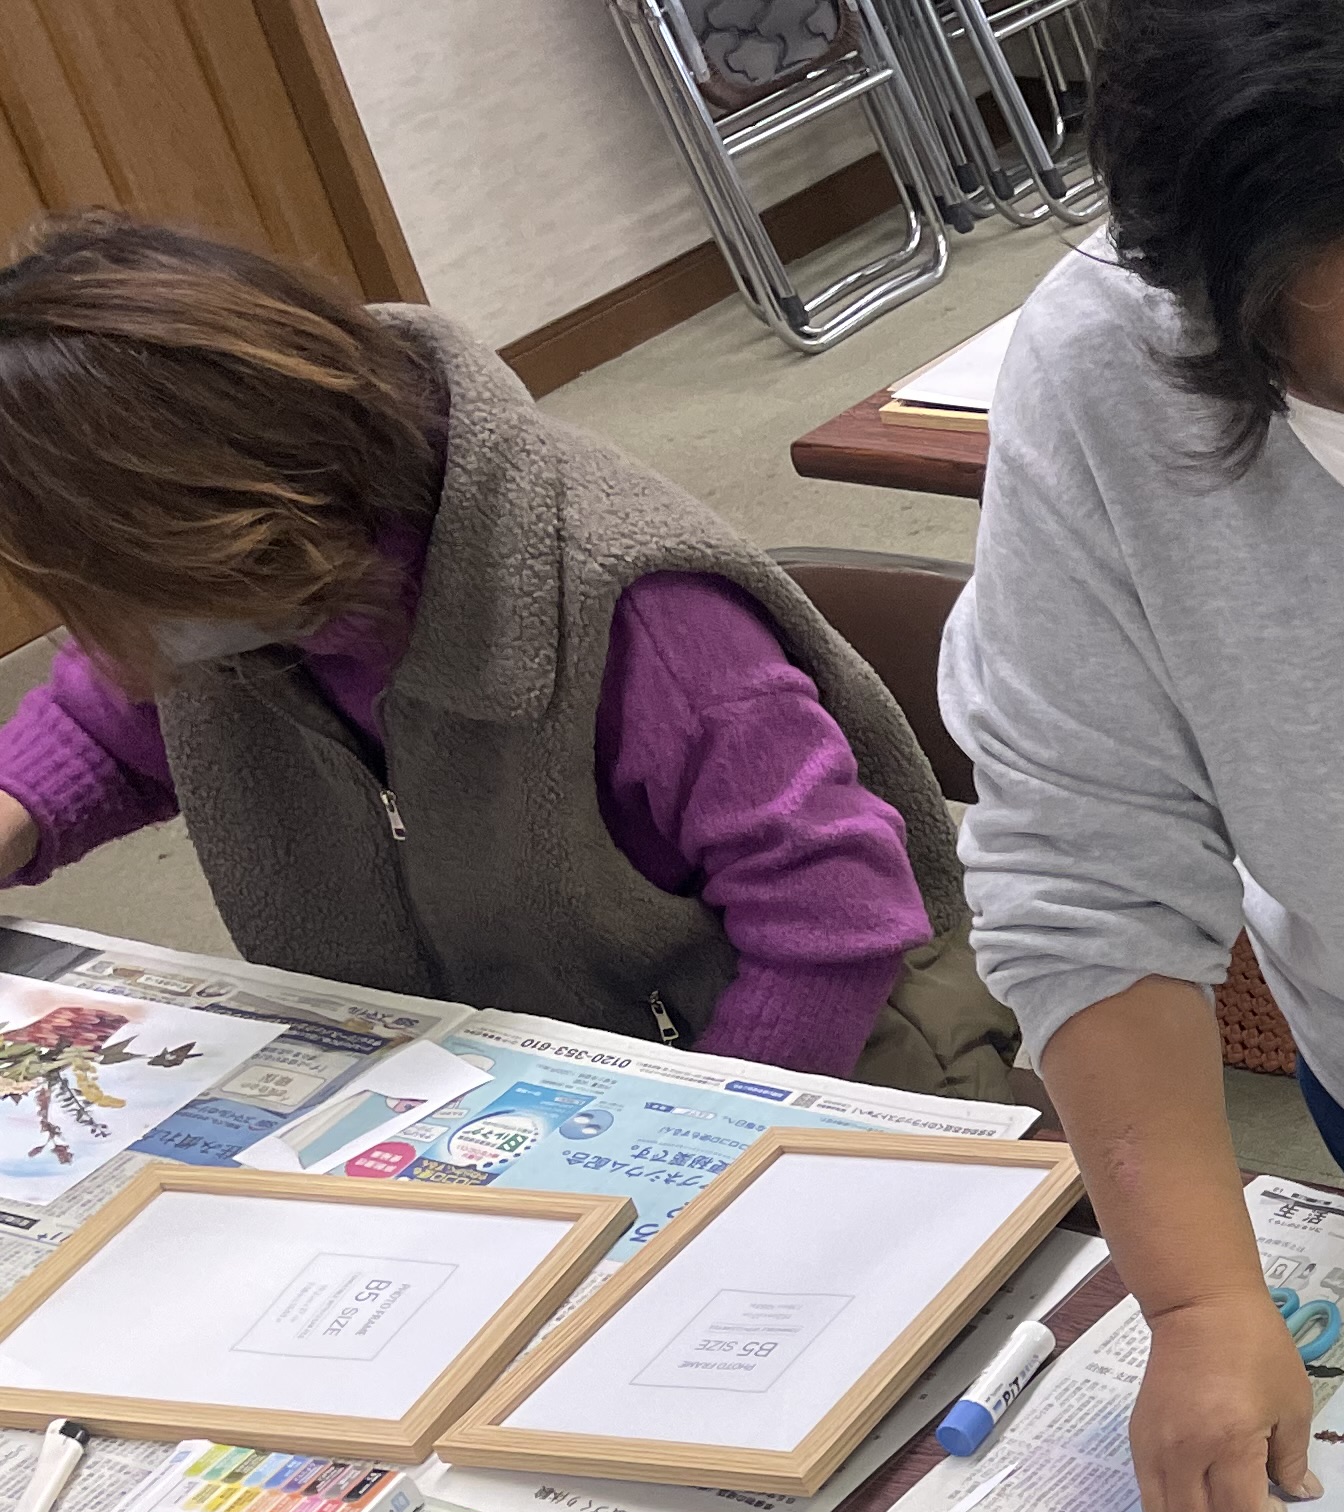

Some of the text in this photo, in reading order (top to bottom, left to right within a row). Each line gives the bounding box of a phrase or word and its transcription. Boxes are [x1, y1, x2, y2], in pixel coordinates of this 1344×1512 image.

[519, 1036, 634, 1071] 0120-353-610
[1272, 1202, 1330, 1227] 生活
[354, 1277, 392, 1303] B5
[321, 1301, 360, 1337] SIZE
[694, 1338, 780, 1360] B5 SIZE
